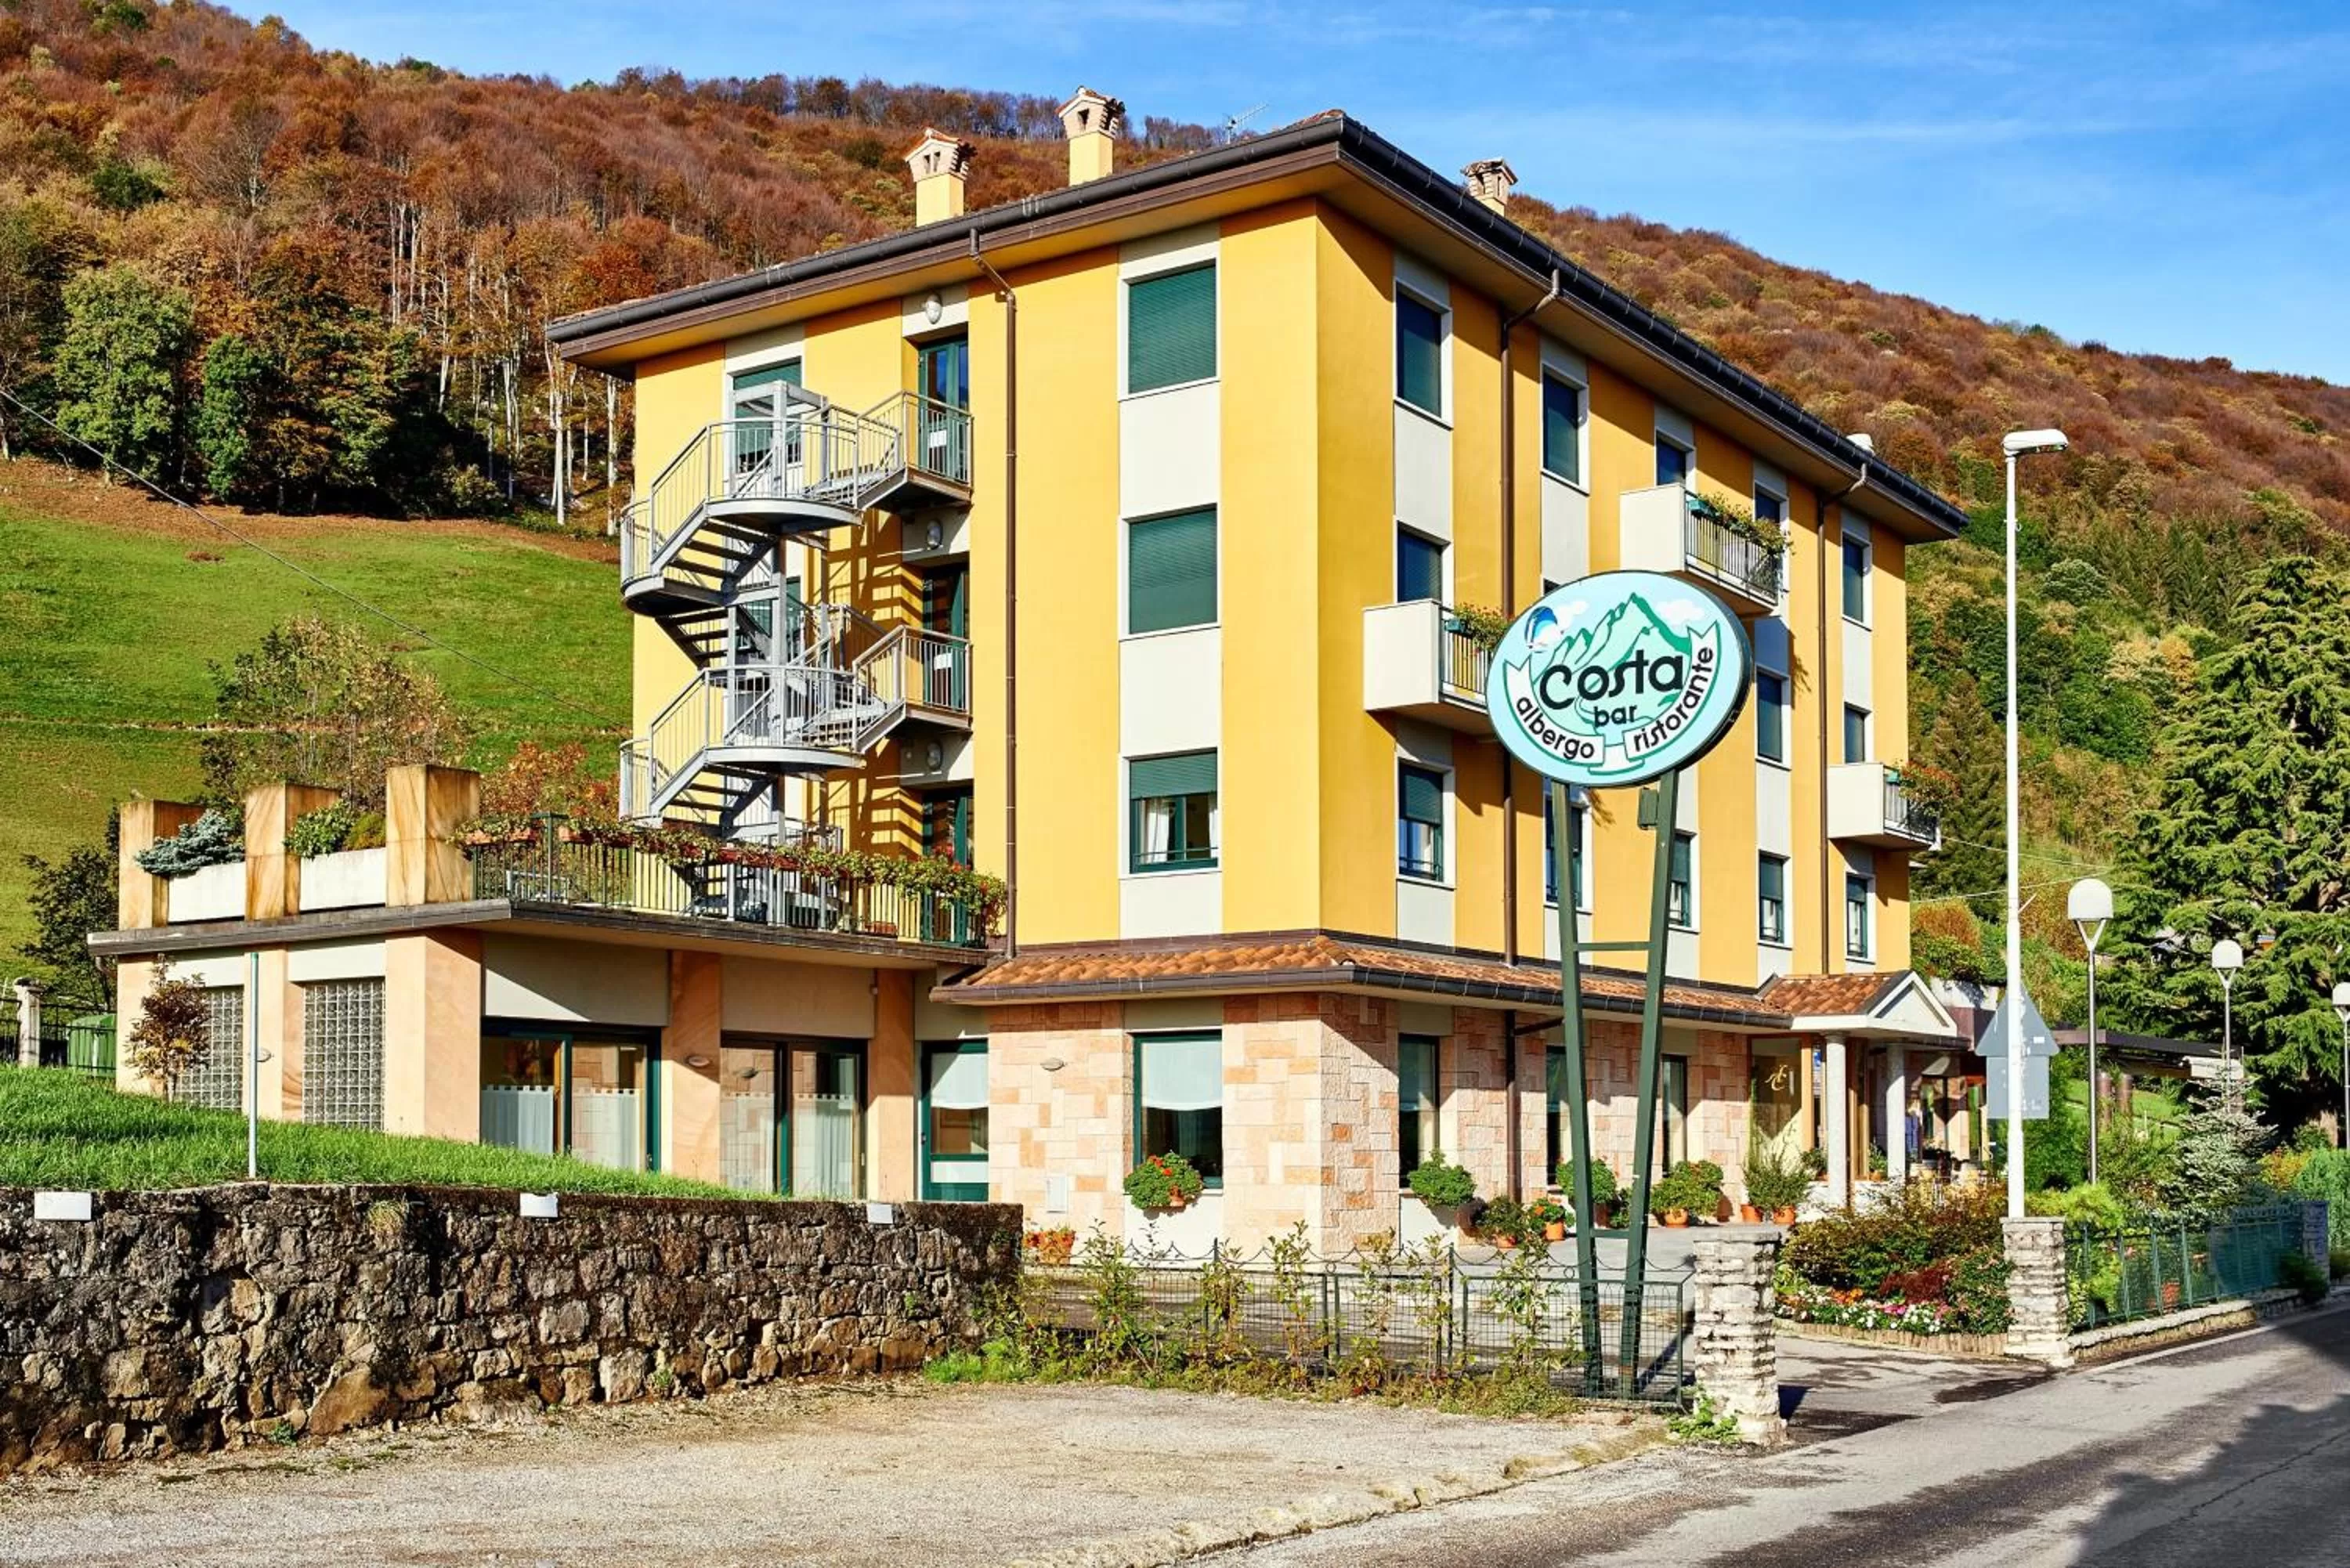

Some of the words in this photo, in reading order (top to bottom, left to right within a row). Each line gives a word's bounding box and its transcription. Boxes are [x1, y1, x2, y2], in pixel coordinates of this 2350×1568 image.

[1539, 649, 1684, 710] Costa
[1633, 646, 1715, 752] ristorante
[1517, 696, 1595, 760] albergo
[1593, 705, 1637, 728] bar
